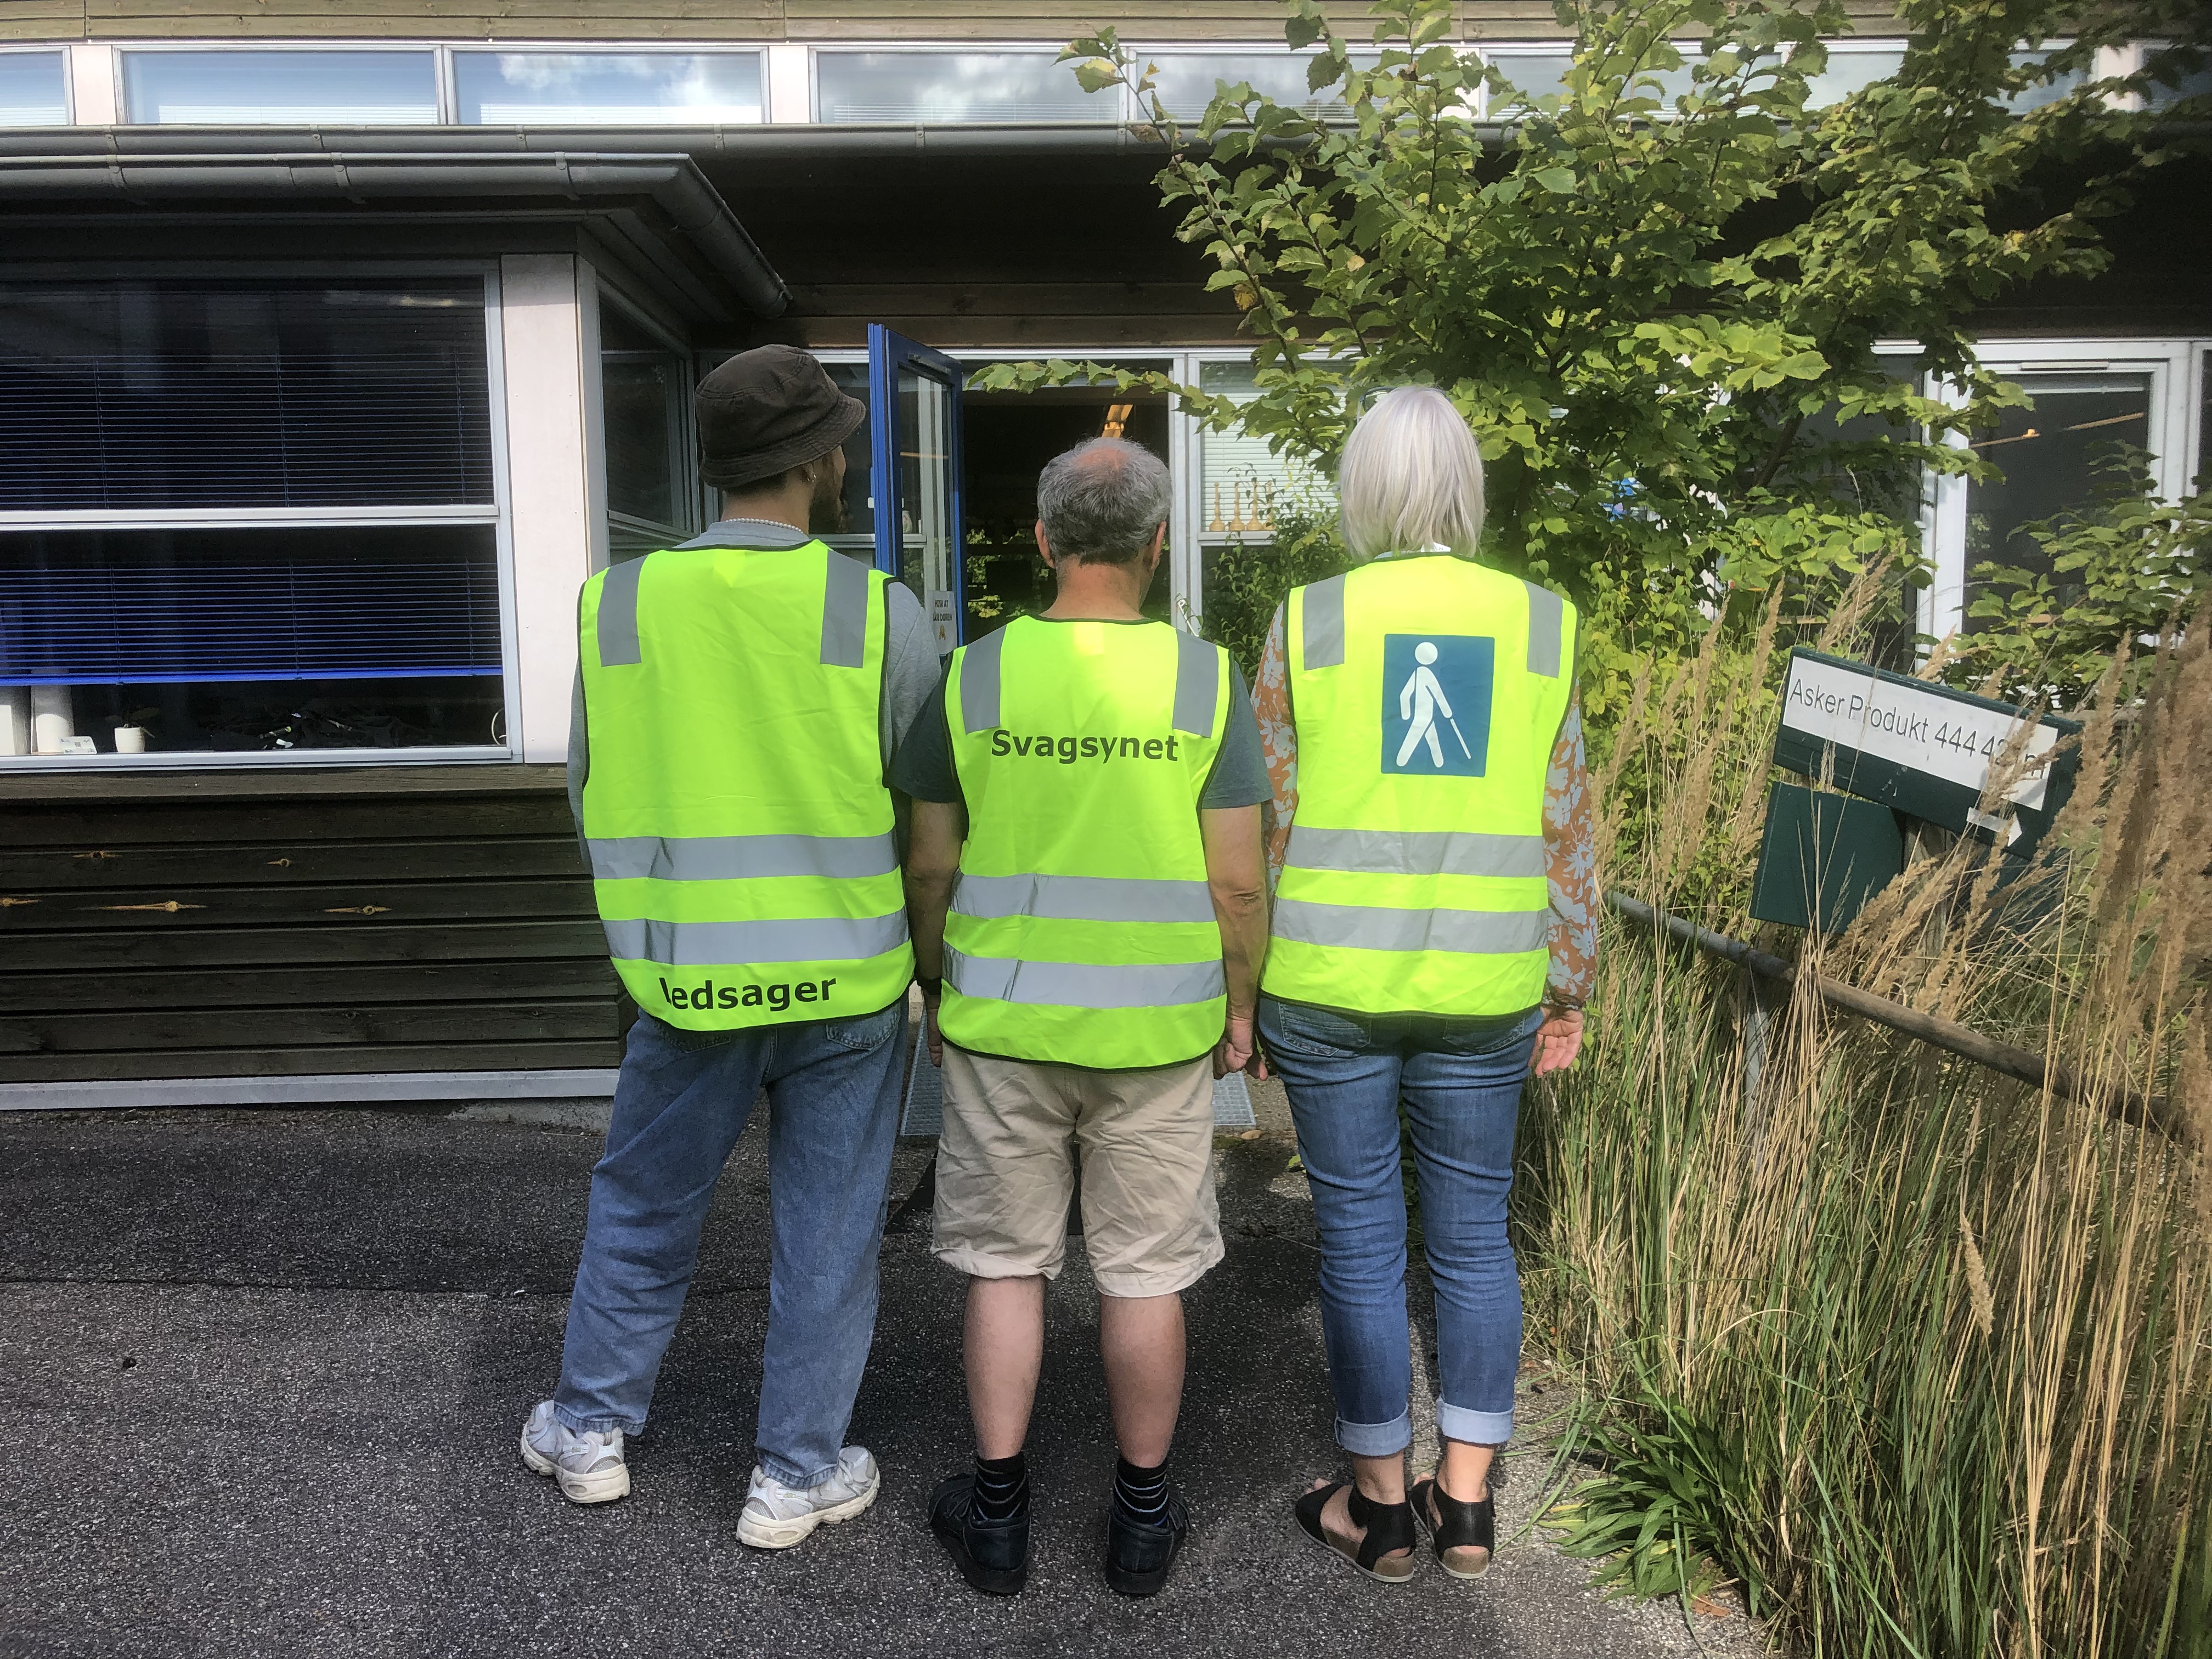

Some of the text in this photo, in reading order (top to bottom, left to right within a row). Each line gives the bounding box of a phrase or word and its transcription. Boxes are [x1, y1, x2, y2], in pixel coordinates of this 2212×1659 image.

[991, 729, 1179, 764] Svagsynet
[1788, 678, 1846, 715] Asker
[1848, 694, 1929, 743] Produkt
[1934, 722, 1977, 758] 444
